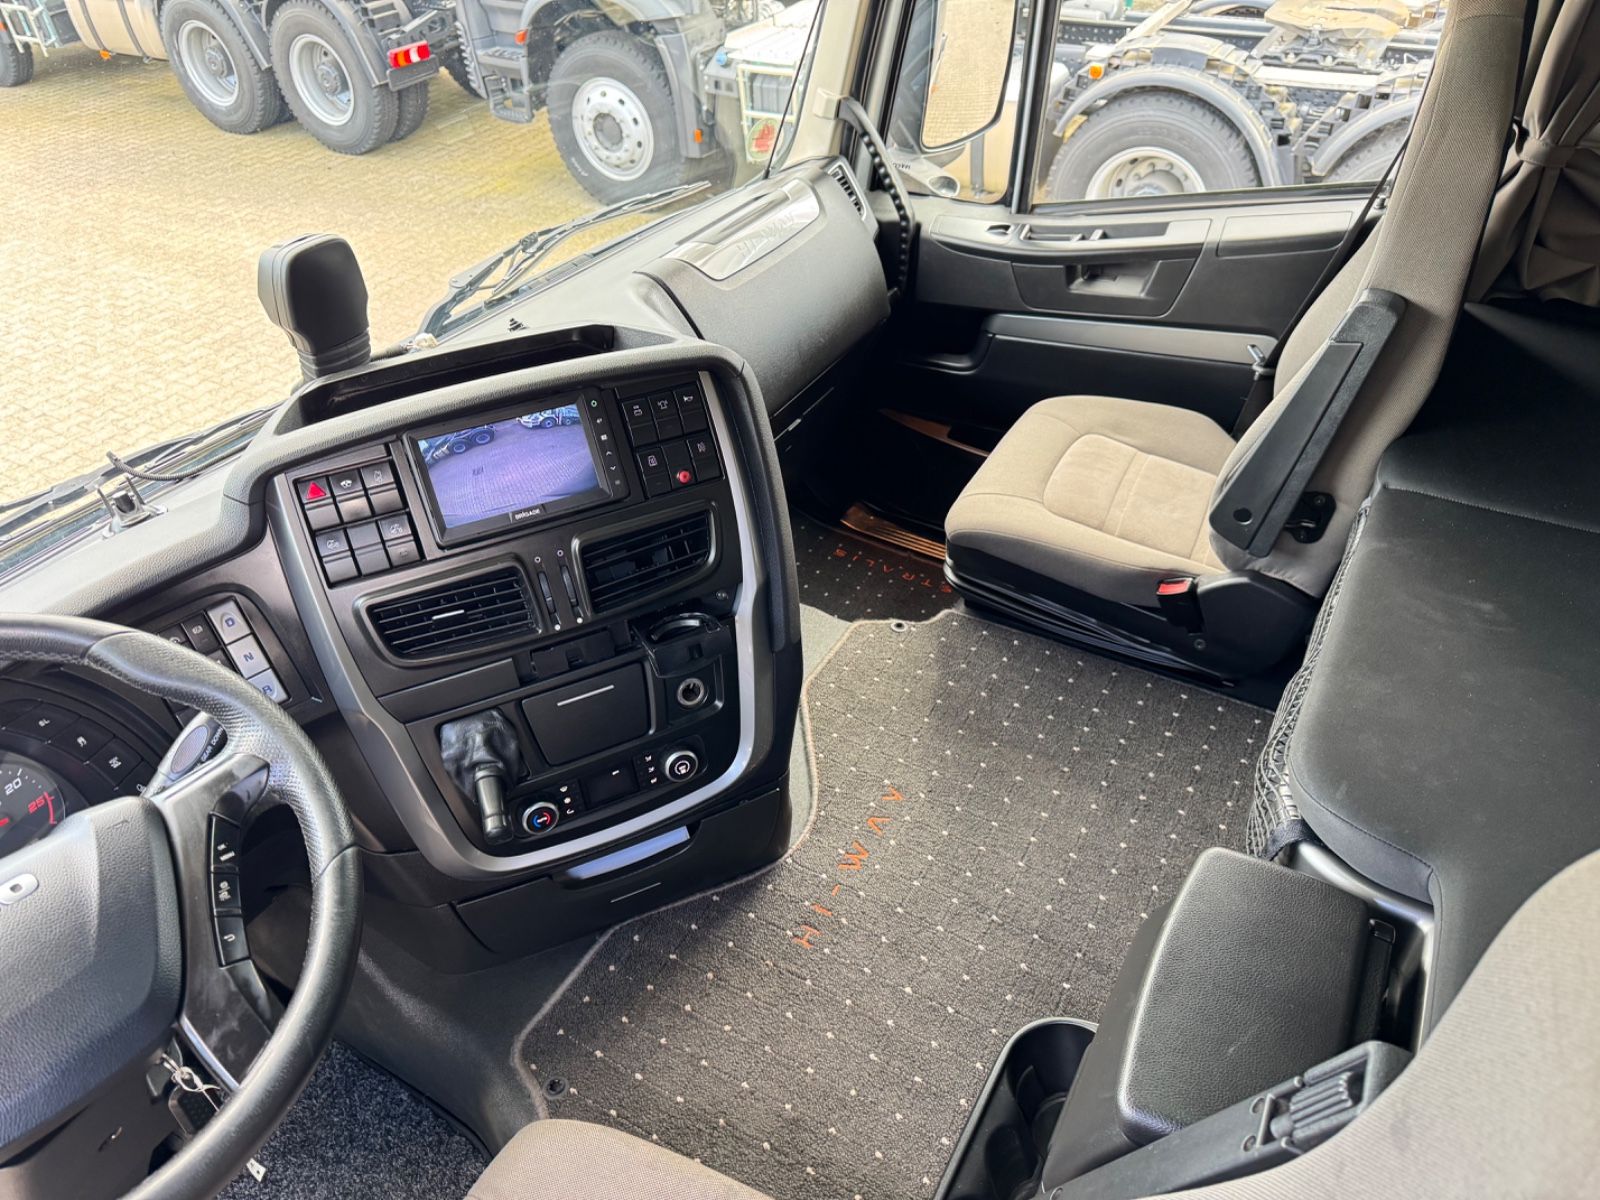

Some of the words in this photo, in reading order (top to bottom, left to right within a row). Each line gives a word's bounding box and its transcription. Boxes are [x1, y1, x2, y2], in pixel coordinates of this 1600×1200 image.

[224, 617, 236, 628] D
[243, 651, 255, 663] N
[261, 684, 273, 696] R
[4, 777, 22, 796] 20
[27, 794, 46, 814] 25
